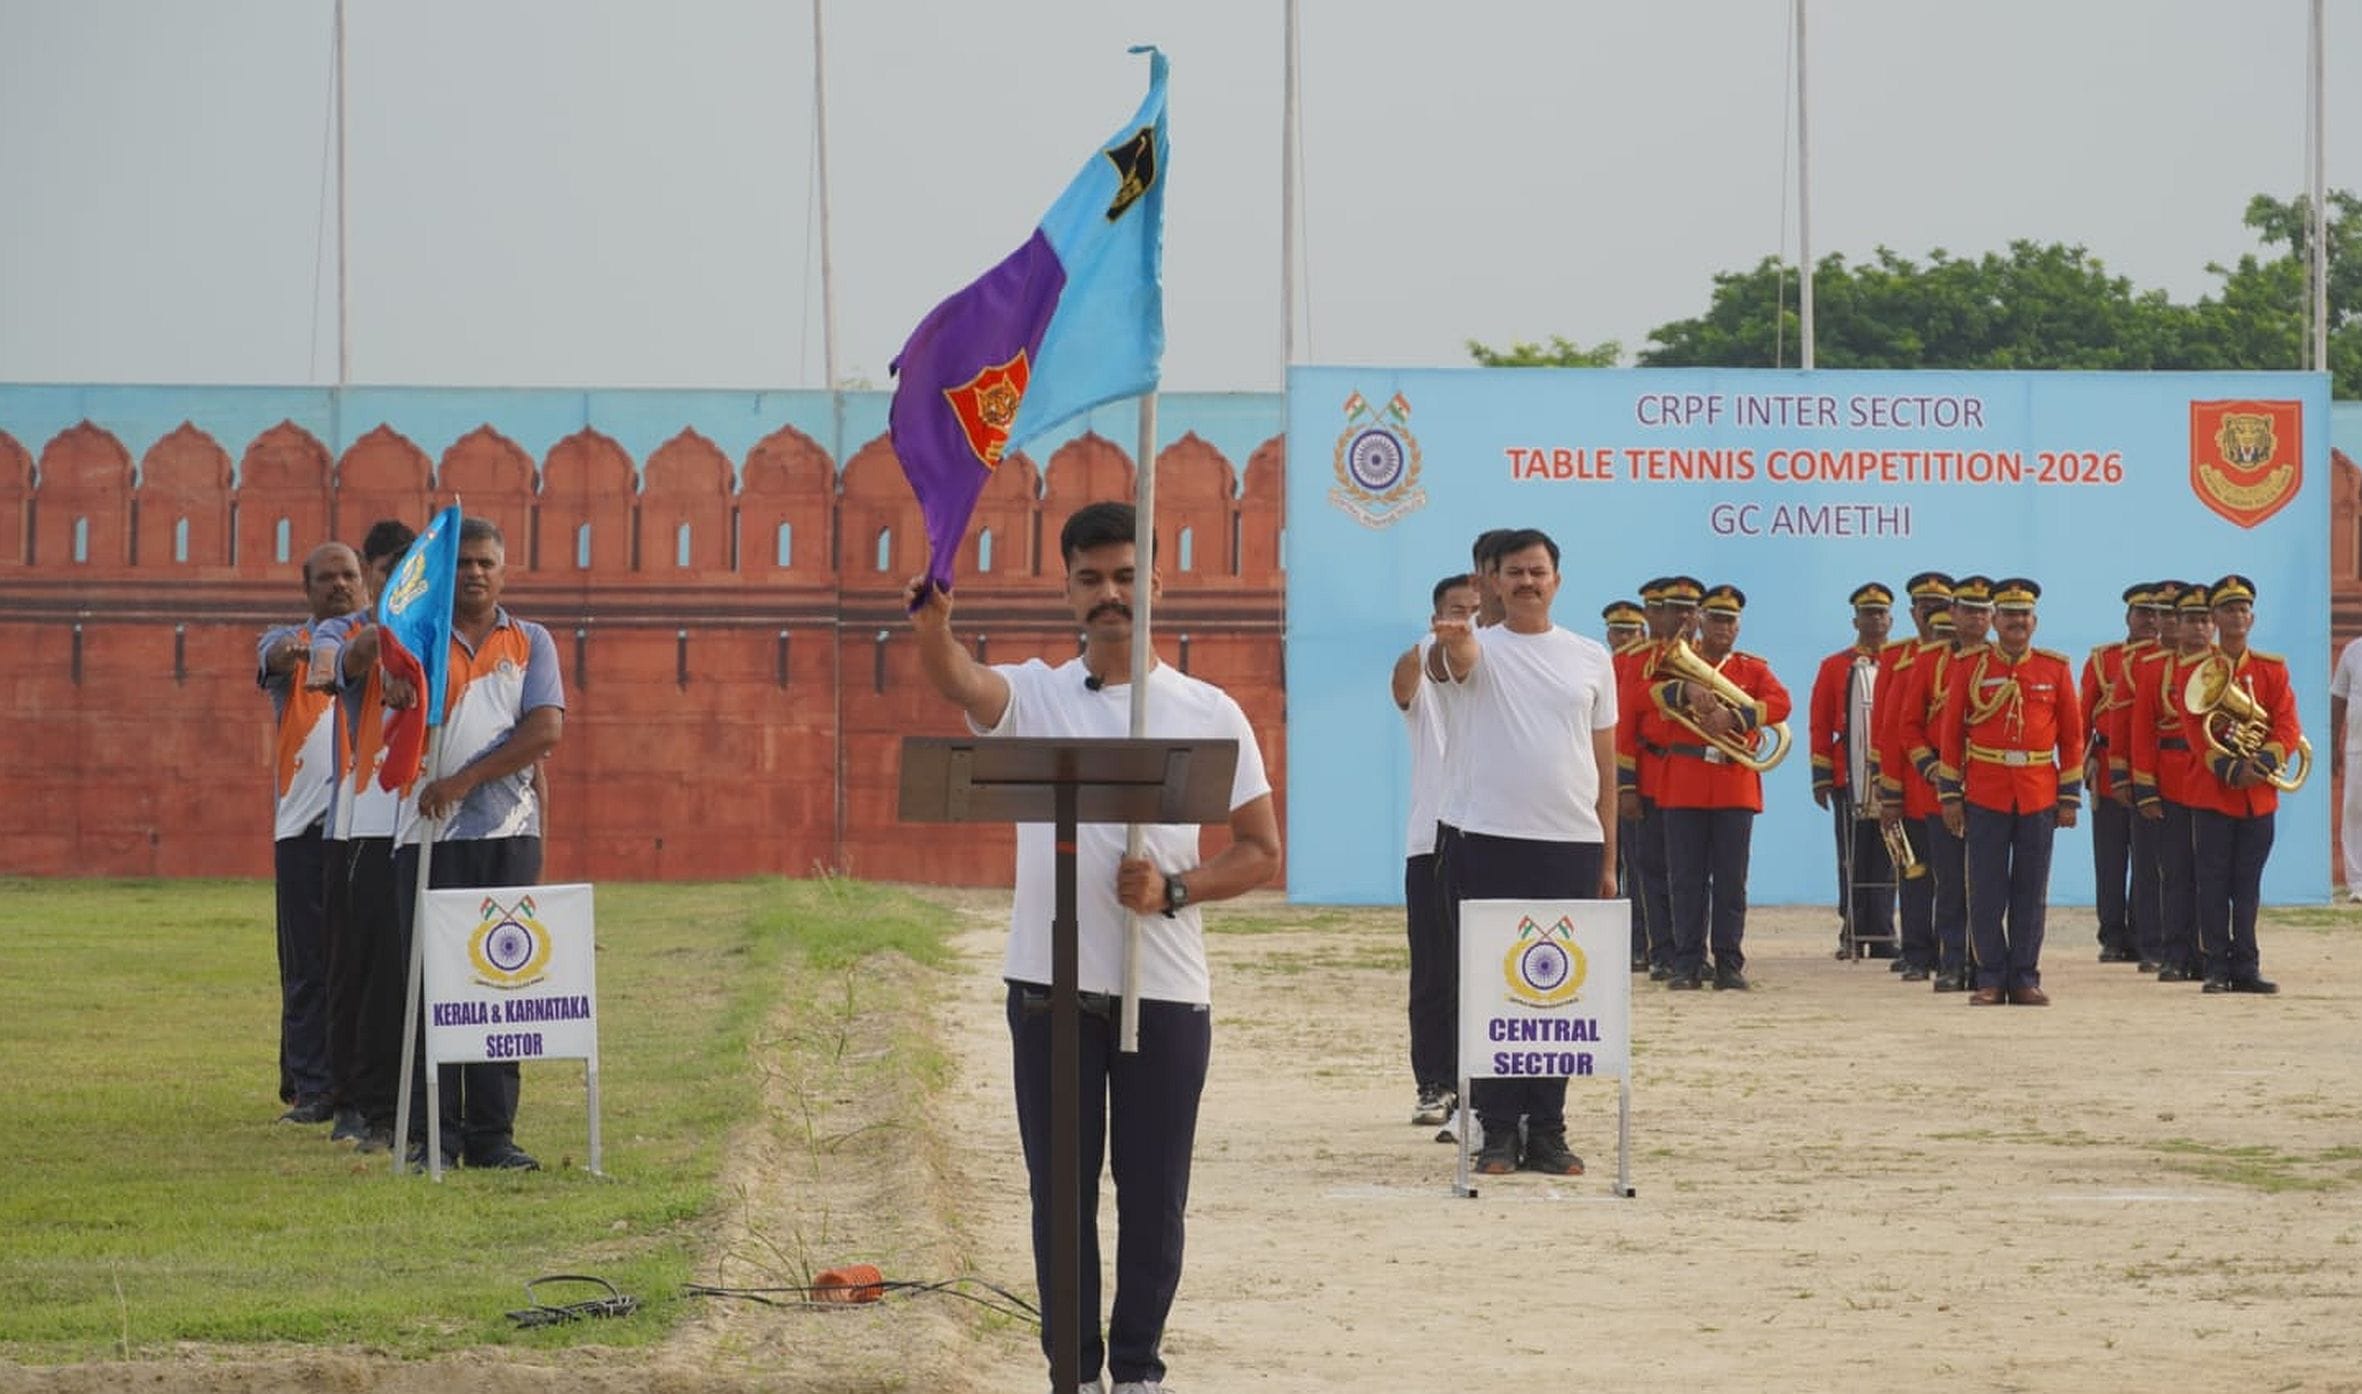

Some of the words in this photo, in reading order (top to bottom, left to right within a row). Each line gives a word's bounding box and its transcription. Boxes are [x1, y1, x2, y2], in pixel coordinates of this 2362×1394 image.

[1636, 395, 1723, 428] CRPF
[1736, 395, 1838, 428] INTER
[1850, 395, 1984, 429] SECTOR
[1507, 448, 1613, 481] TABLE
[1624, 449, 1755, 482] TENNIS
[1766, 450, 2123, 484] COMPETITION-2026
[1710, 504, 1760, 535] GC
[1770, 505, 1911, 536] AMETHI
[433, 1001, 489, 1027] KERALA
[491, 1003, 502, 1024] &
[504, 995, 591, 1024] KARNATAKA
[486, 1032, 543, 1059] SECTOR
[1488, 1018, 1601, 1042] CENTRAL
[1493, 1052, 1594, 1076] SECTOR
